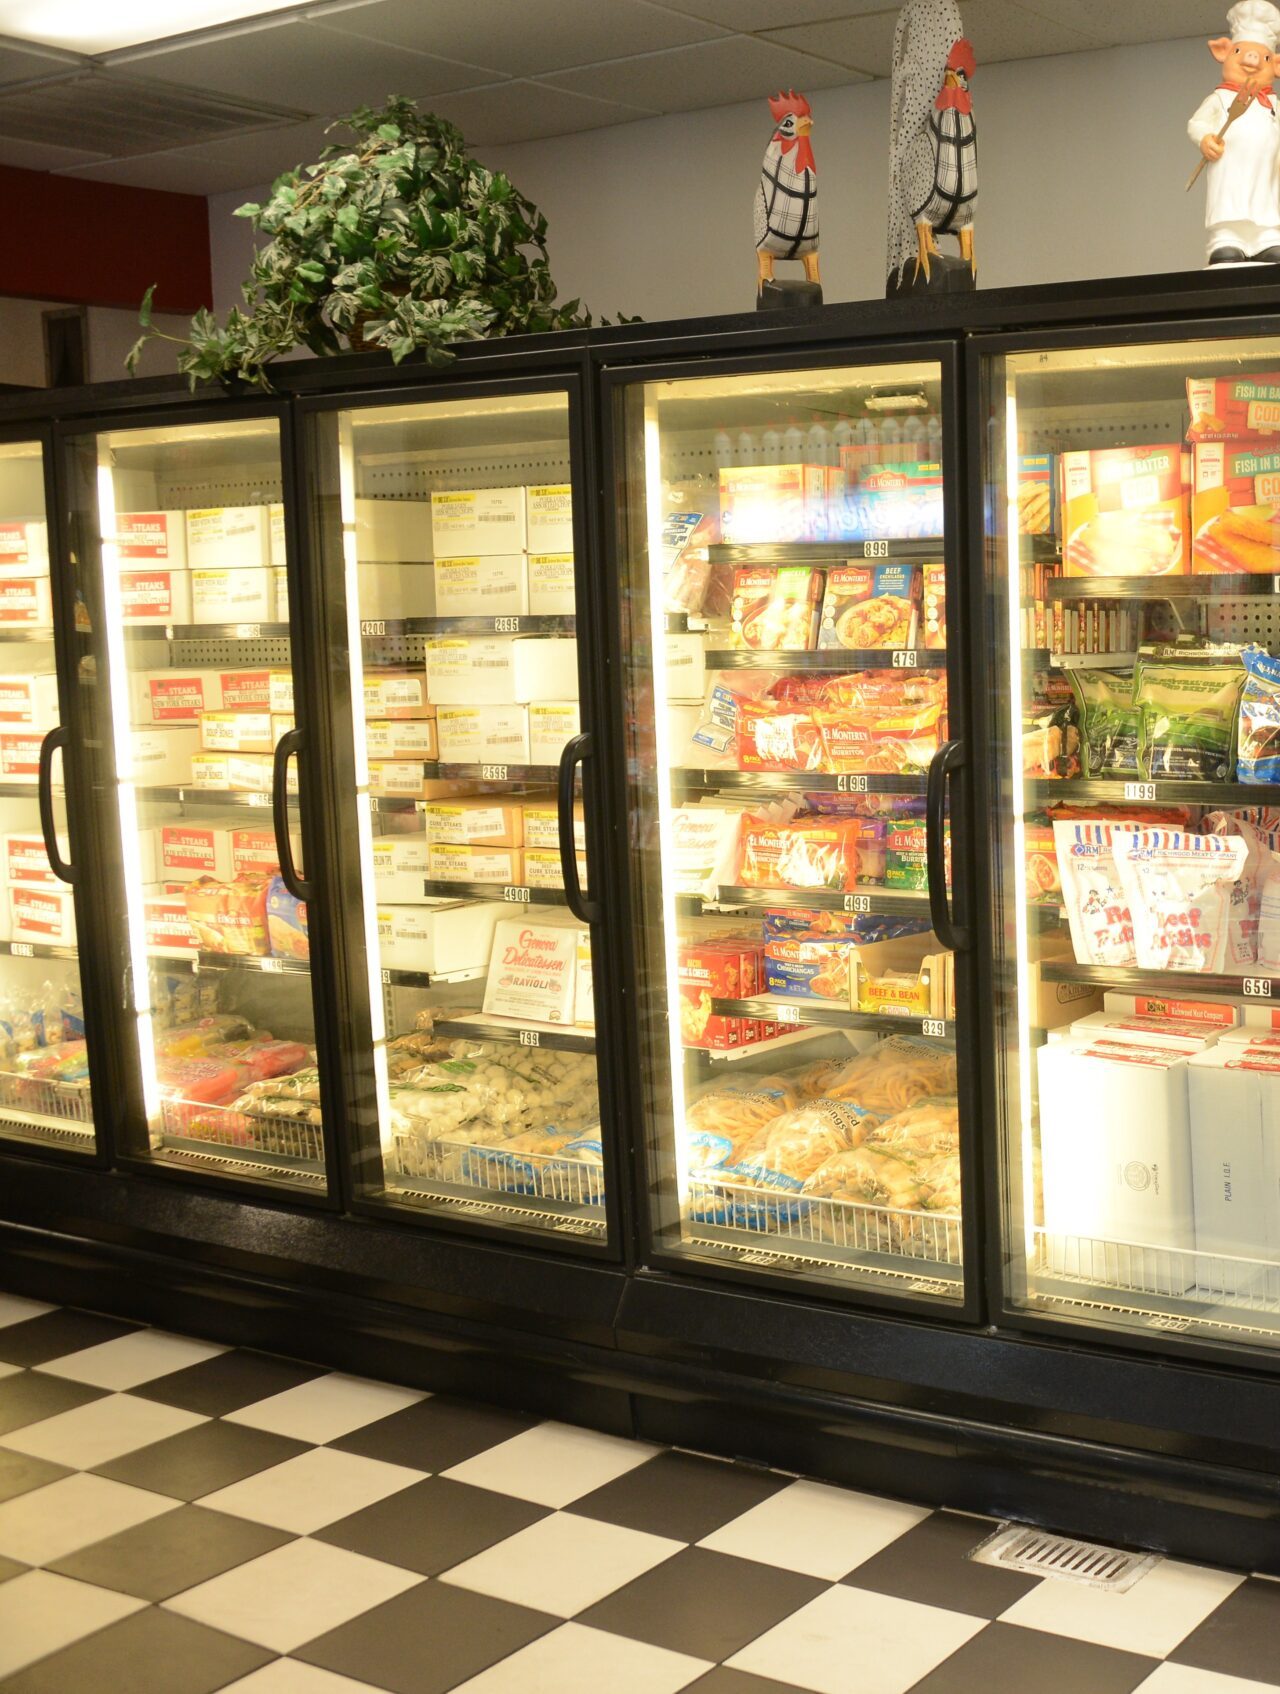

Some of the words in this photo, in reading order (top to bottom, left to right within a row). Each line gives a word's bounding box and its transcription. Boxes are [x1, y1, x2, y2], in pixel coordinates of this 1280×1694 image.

[1235, 386, 1254, 397] FISH
[1257, 386, 1267, 397] IN
[1254, 405, 1280, 423] COD
[1136, 456, 1170, 473] BATTER
[1235, 460, 1258, 474] FISH
[1260, 458, 1271, 471] IN
[878, 478, 905, 488] MONTEREY
[132, 523, 161, 533] STEAKS
[864, 542, 888, 556] 899
[885, 567, 901, 575] BEEF
[136, 581, 165, 590] STEAKS
[840, 575, 867, 584] MONTEREY
[362, 622, 384, 634] 4200
[496, 618, 518, 631] 2895
[893, 652, 916, 666] 479
[169, 686, 197, 696] STEAKS
[833, 729, 867, 741] MONTEREY
[832, 748, 865, 757] BURRITOS
[483, 766, 507, 780] 2595
[1126, 784, 1155, 799] 1199
[181, 837, 208, 847] STEAKS
[758, 838, 790, 848] MONTEREY
[1085, 846, 1099, 855] RM
[505, 888, 529, 901] 4900
[845, 896, 870, 910] 499
[777, 964, 815, 975] CHIMICHANGAS
[512, 976, 548, 989] RAVIOLI
[769, 977, 775, 985] 8
[1244, 980, 1270, 995] 659
[868, 988, 888, 997] BEEF
[891, 988, 897, 997] &
[898, 990, 919, 1000] BEAN
[1172, 1007, 1192, 1017] Richwood
[1192, 1008, 1204, 1018] Meat
[1204, 1010, 1224, 1021] Company
[924, 1021, 944, 1034] 329
[521, 1032, 538, 1045] 799
